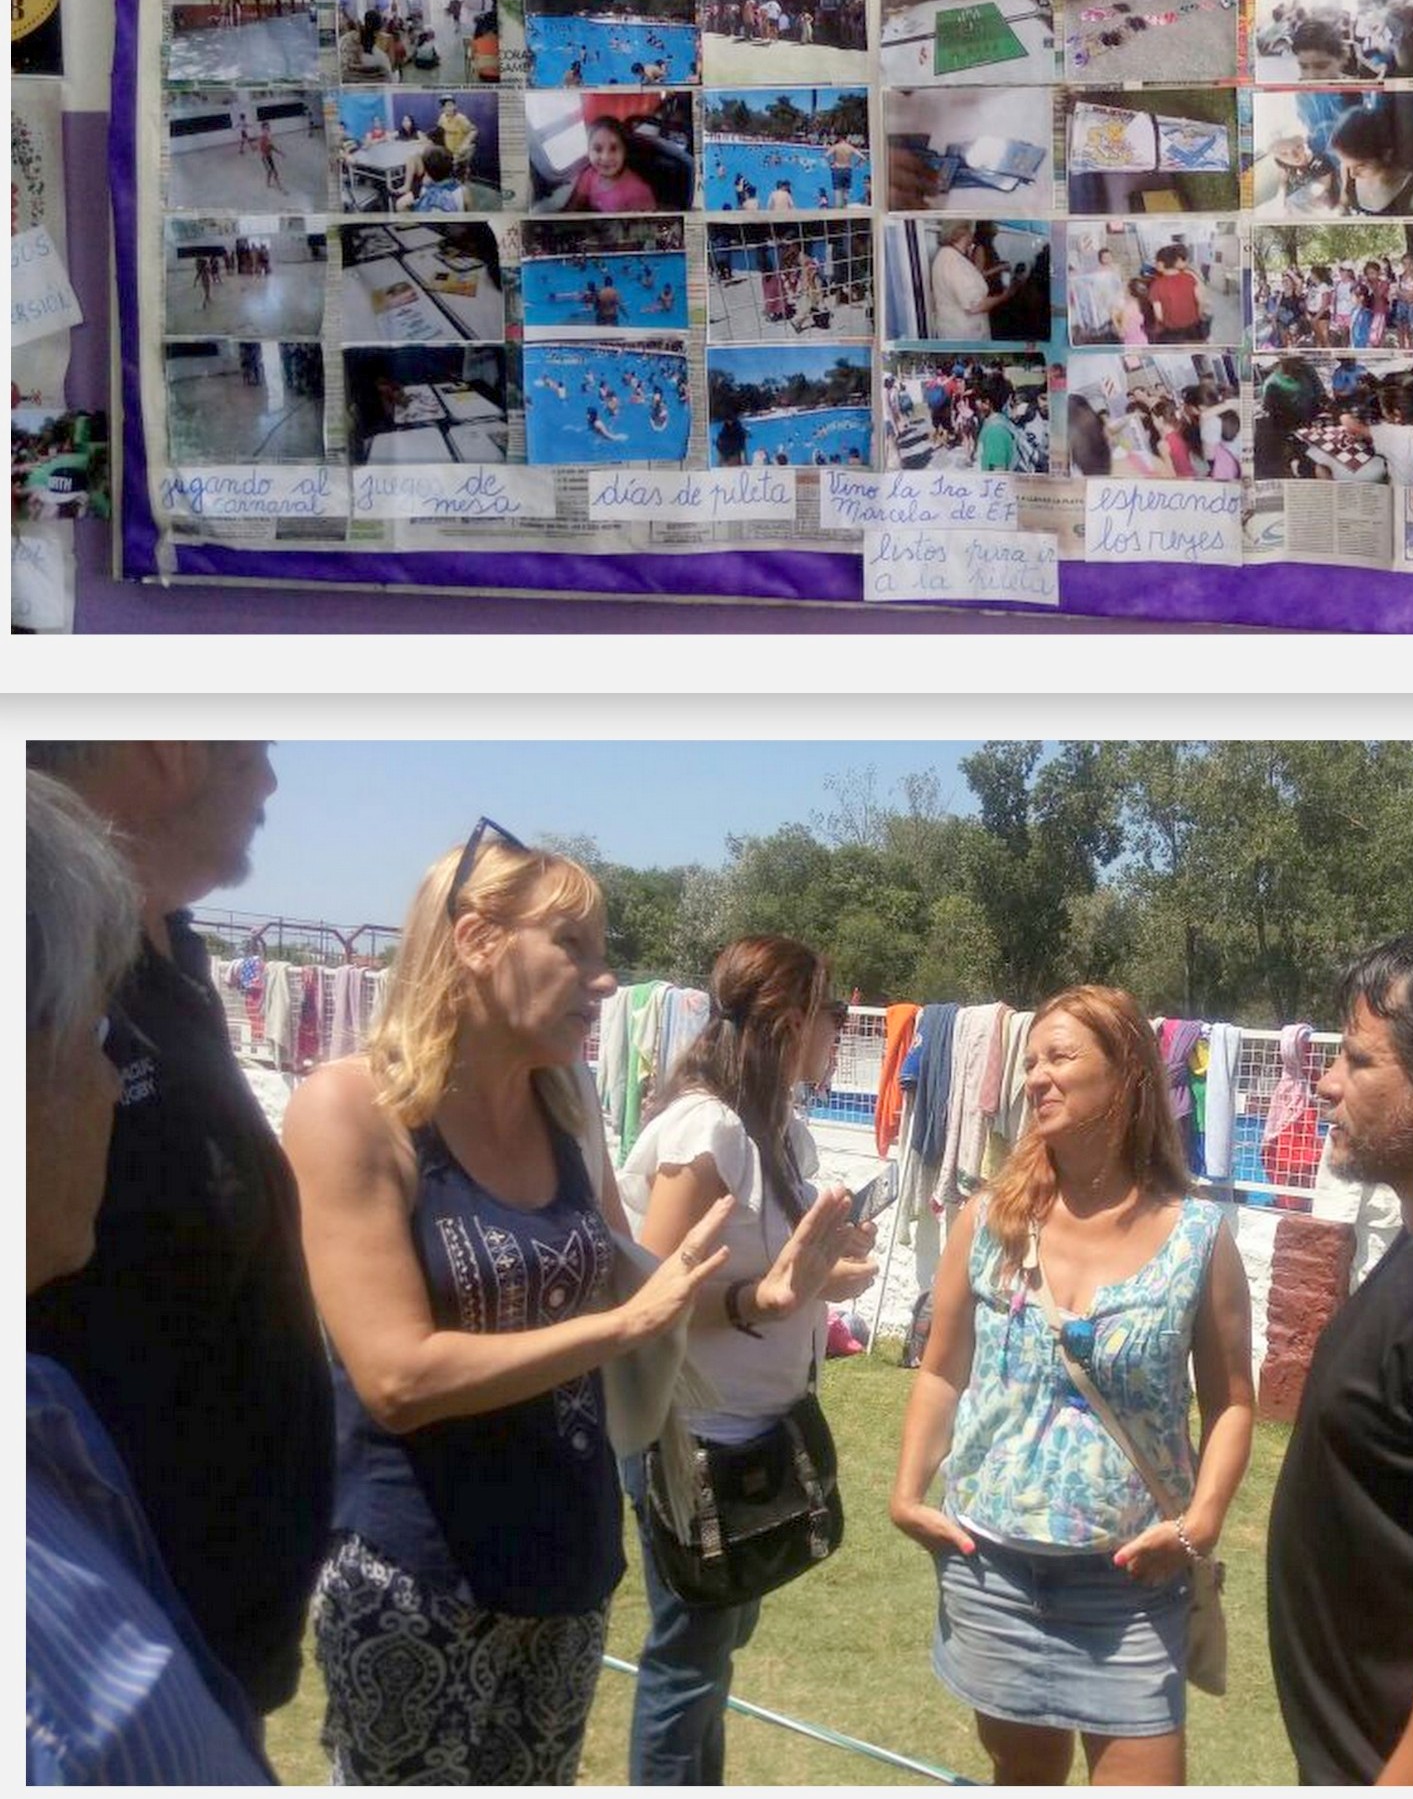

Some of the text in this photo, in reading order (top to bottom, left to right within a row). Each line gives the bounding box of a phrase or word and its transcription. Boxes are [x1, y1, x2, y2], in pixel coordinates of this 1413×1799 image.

[158, 467, 332, 514] jugando al
[458, 464, 507, 497] de
[669, 474, 704, 507] de
[709, 468, 794, 517] pileta
[887, 468, 922, 500] la
[422, 495, 523, 517] mesa
[829, 496, 938, 523] Marcela
[950, 500, 977, 521] de
[1087, 483, 1241, 527] esperando
[869, 532, 948, 565] listos
[964, 536, 1028, 568] para
[1093, 516, 1142, 553] los
[873, 572, 896, 594] a
[912, 566, 952, 592] la
